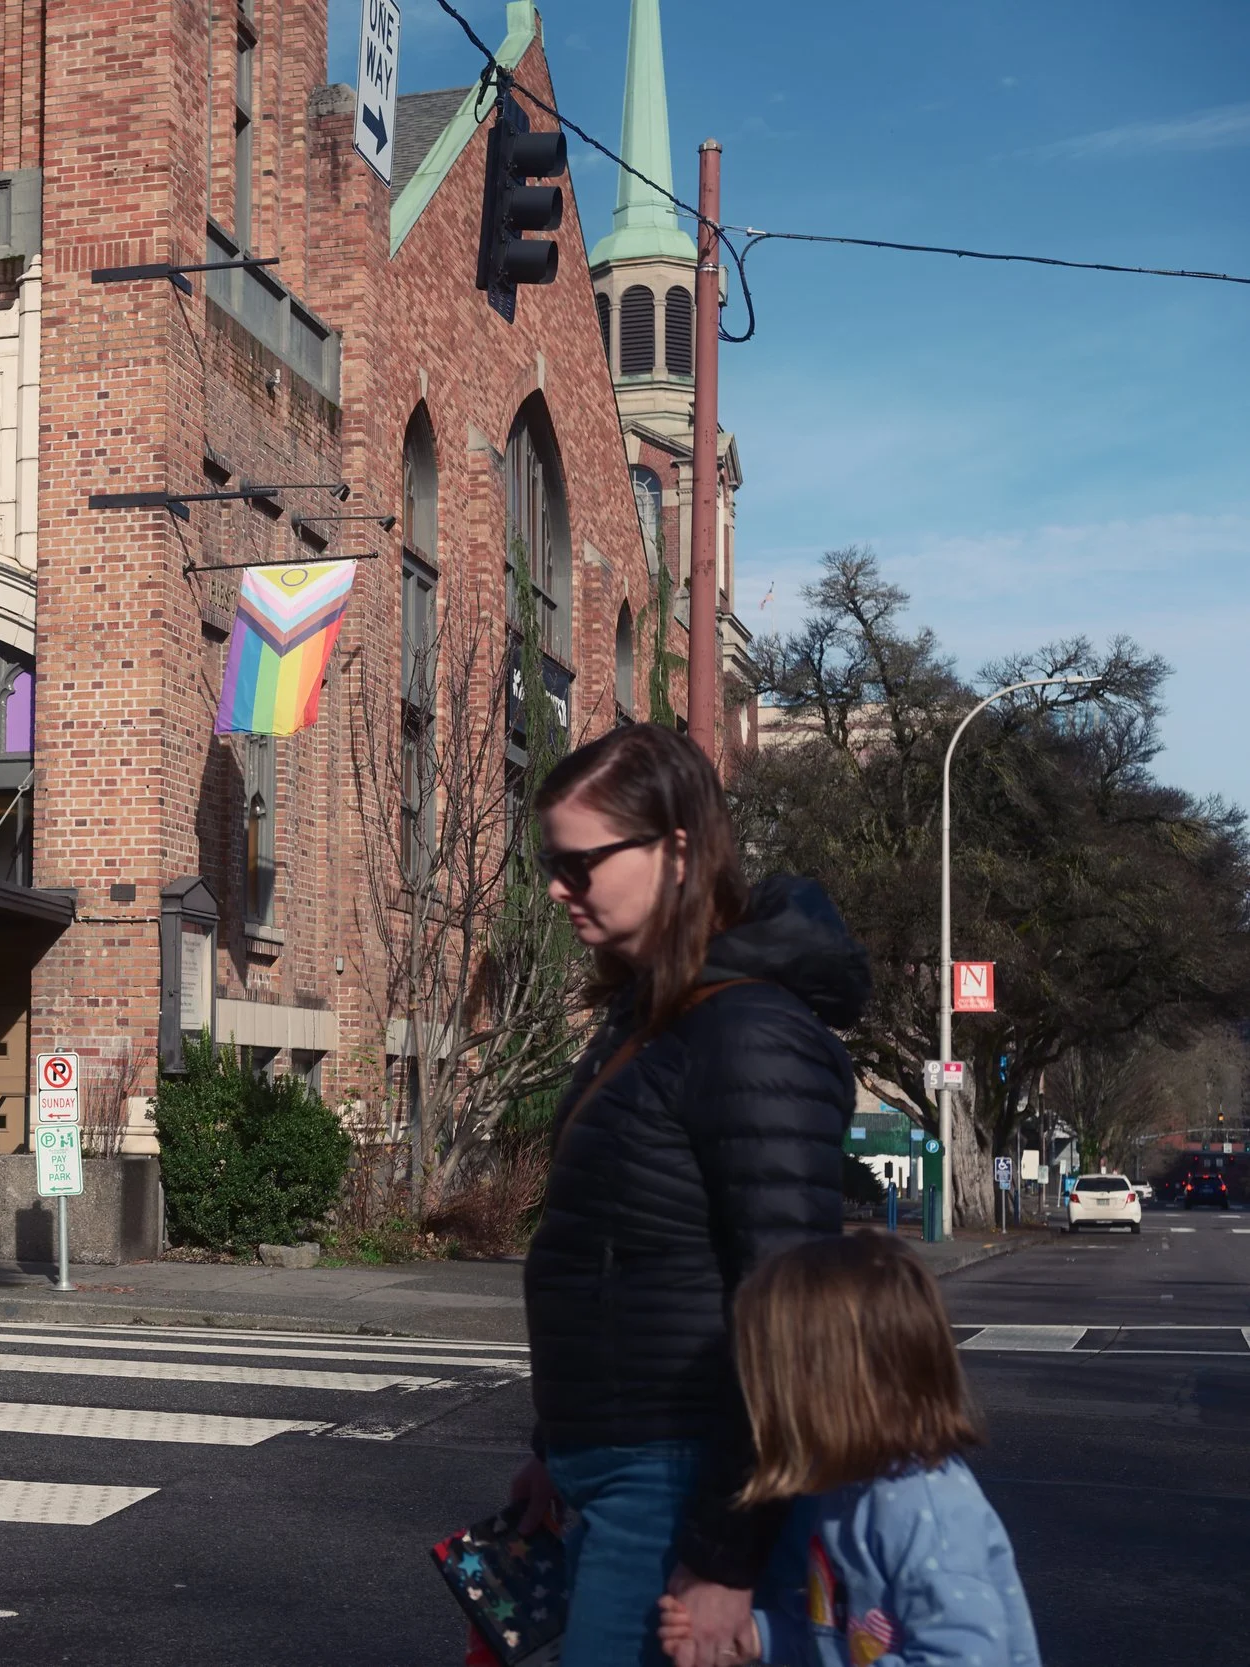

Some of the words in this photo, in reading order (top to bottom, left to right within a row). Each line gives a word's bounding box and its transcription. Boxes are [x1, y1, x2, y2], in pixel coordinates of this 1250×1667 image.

[370, 0, 394, 55] ONE
[367, 37, 393, 101] WAY
[962, 965, 984, 987] N
[930, 1075, 938, 1085] 5
[42, 1098, 75, 1109] SUNDAY
[51, 1155, 67, 1163] PAY
[54, 1164, 65, 1172] TO
[49, 1173, 71, 1181] PARK
